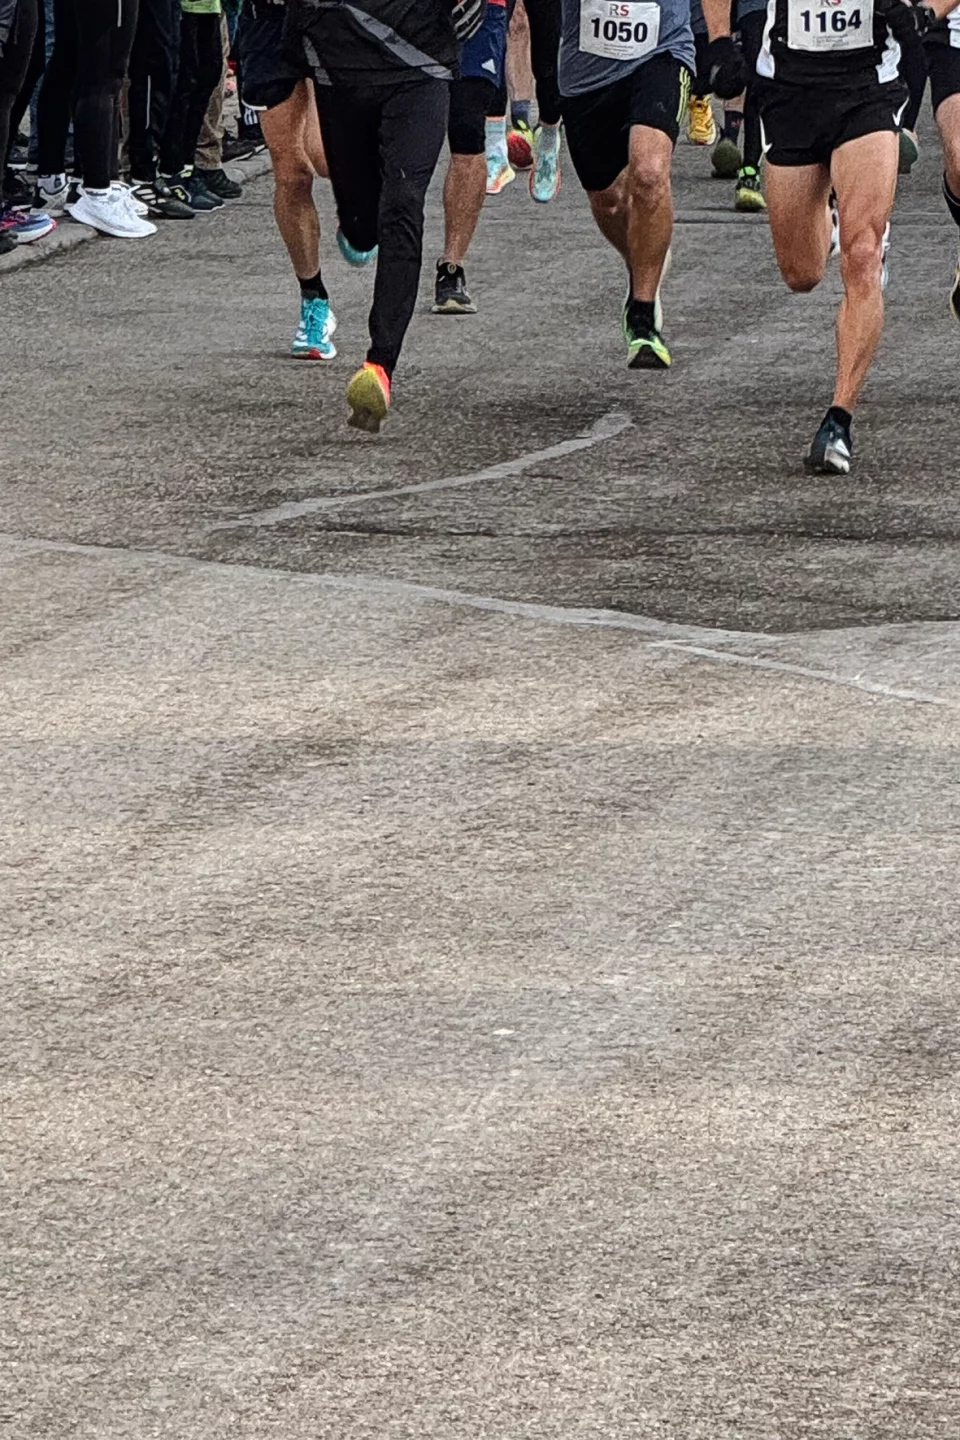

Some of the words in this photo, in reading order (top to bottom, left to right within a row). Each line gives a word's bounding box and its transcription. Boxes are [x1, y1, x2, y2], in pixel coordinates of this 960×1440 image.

[609, 3, 630, 17] RS
[800, 8, 862, 33] 1164
[590, 17, 648, 43] 1050
